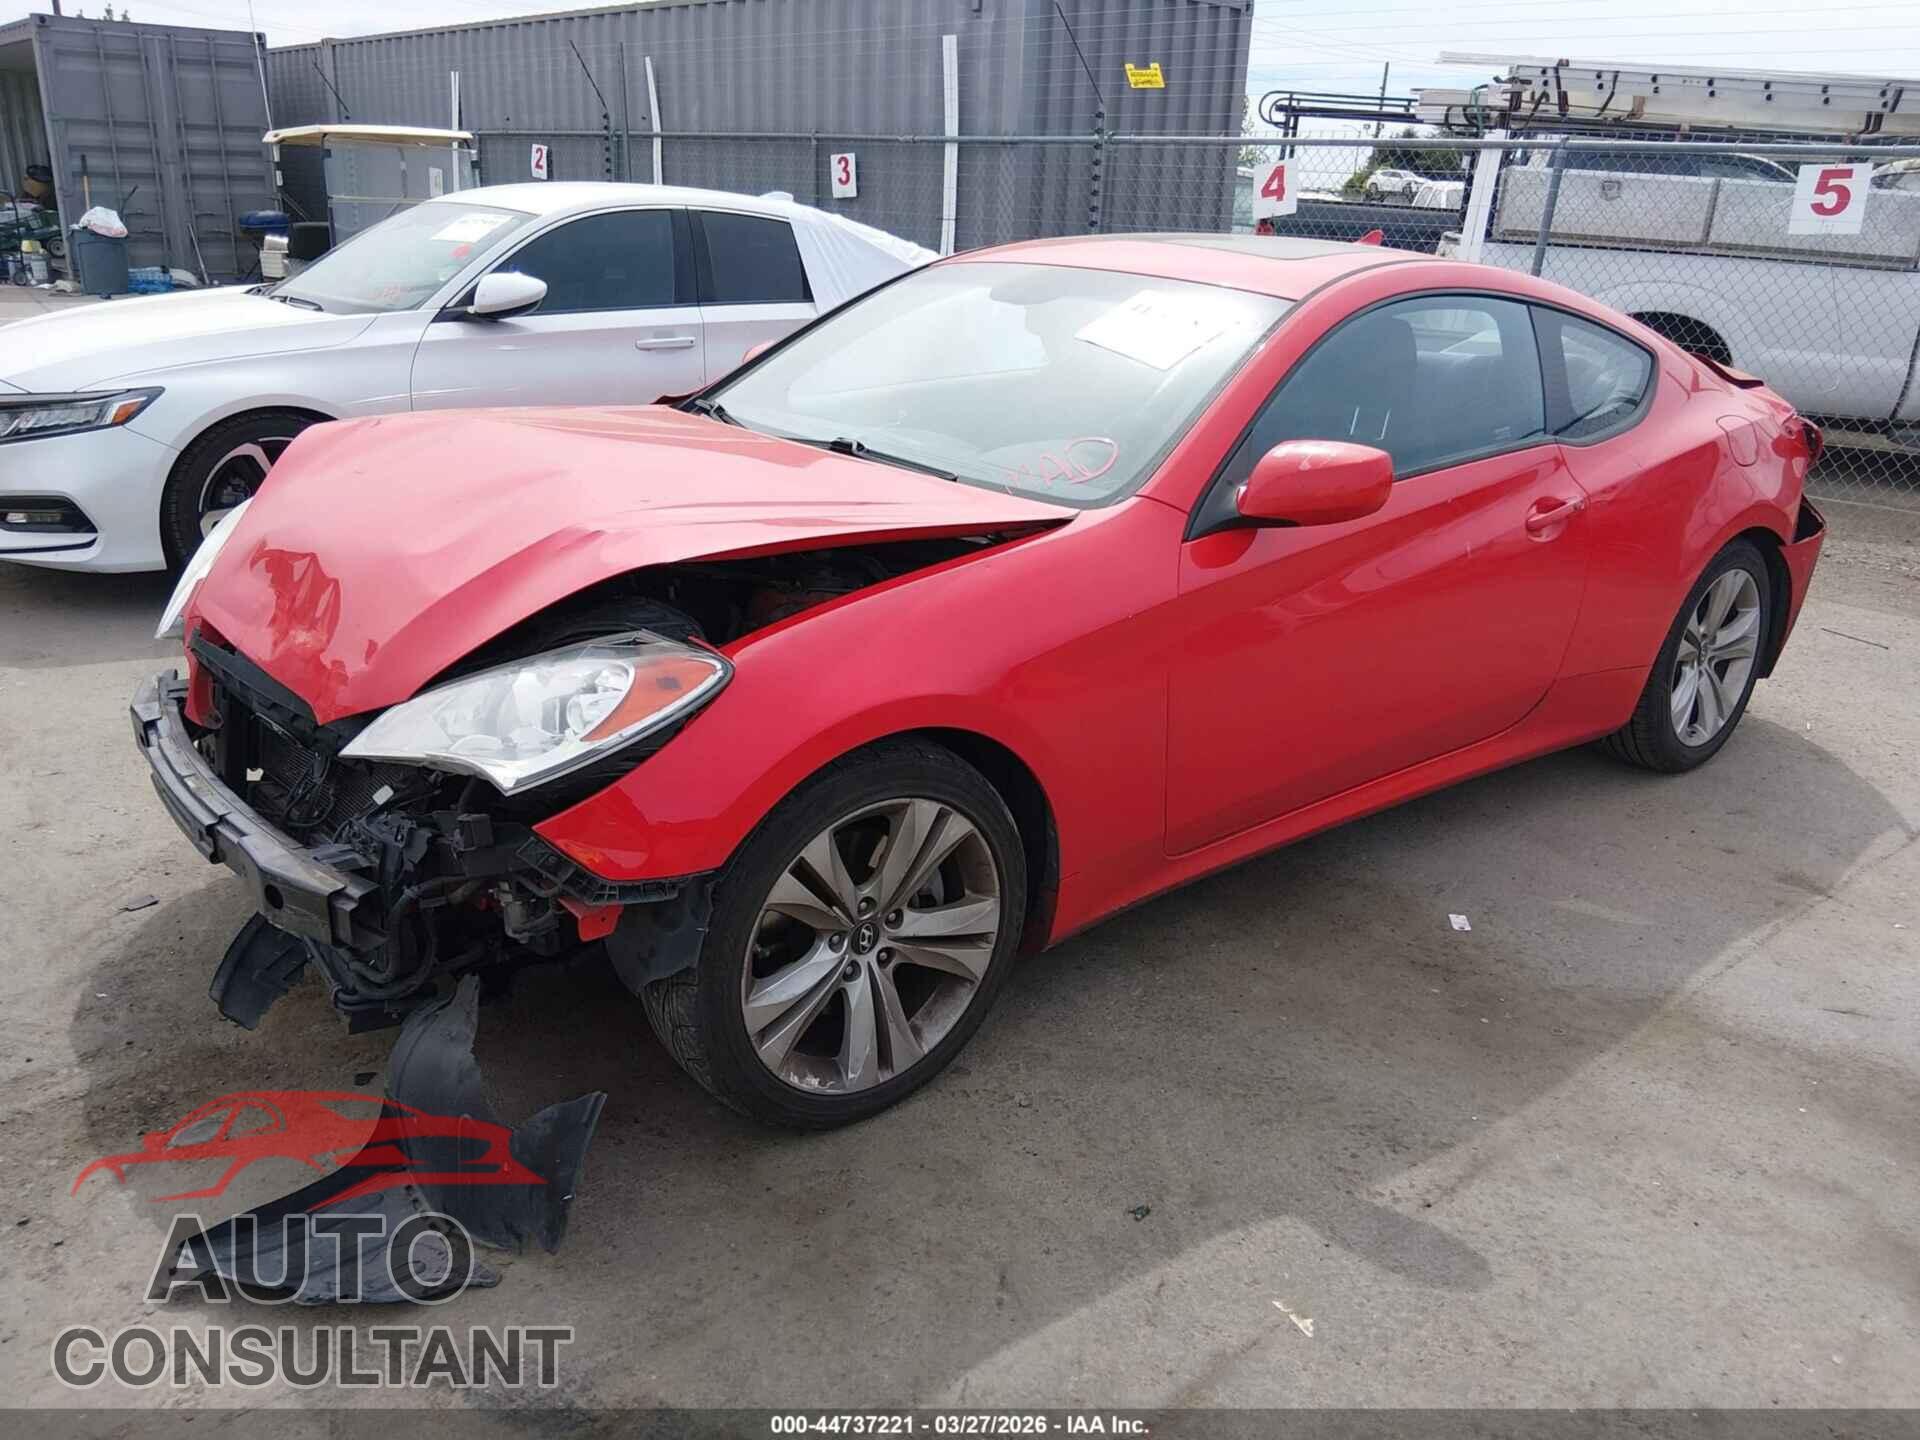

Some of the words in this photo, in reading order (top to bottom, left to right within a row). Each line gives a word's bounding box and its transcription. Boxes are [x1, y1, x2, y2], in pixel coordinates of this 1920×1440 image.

[534, 147, 544, 170] 2
[837, 156, 850, 186] 3
[1261, 165, 1285, 201] 4
[1811, 168, 1854, 216] 5
